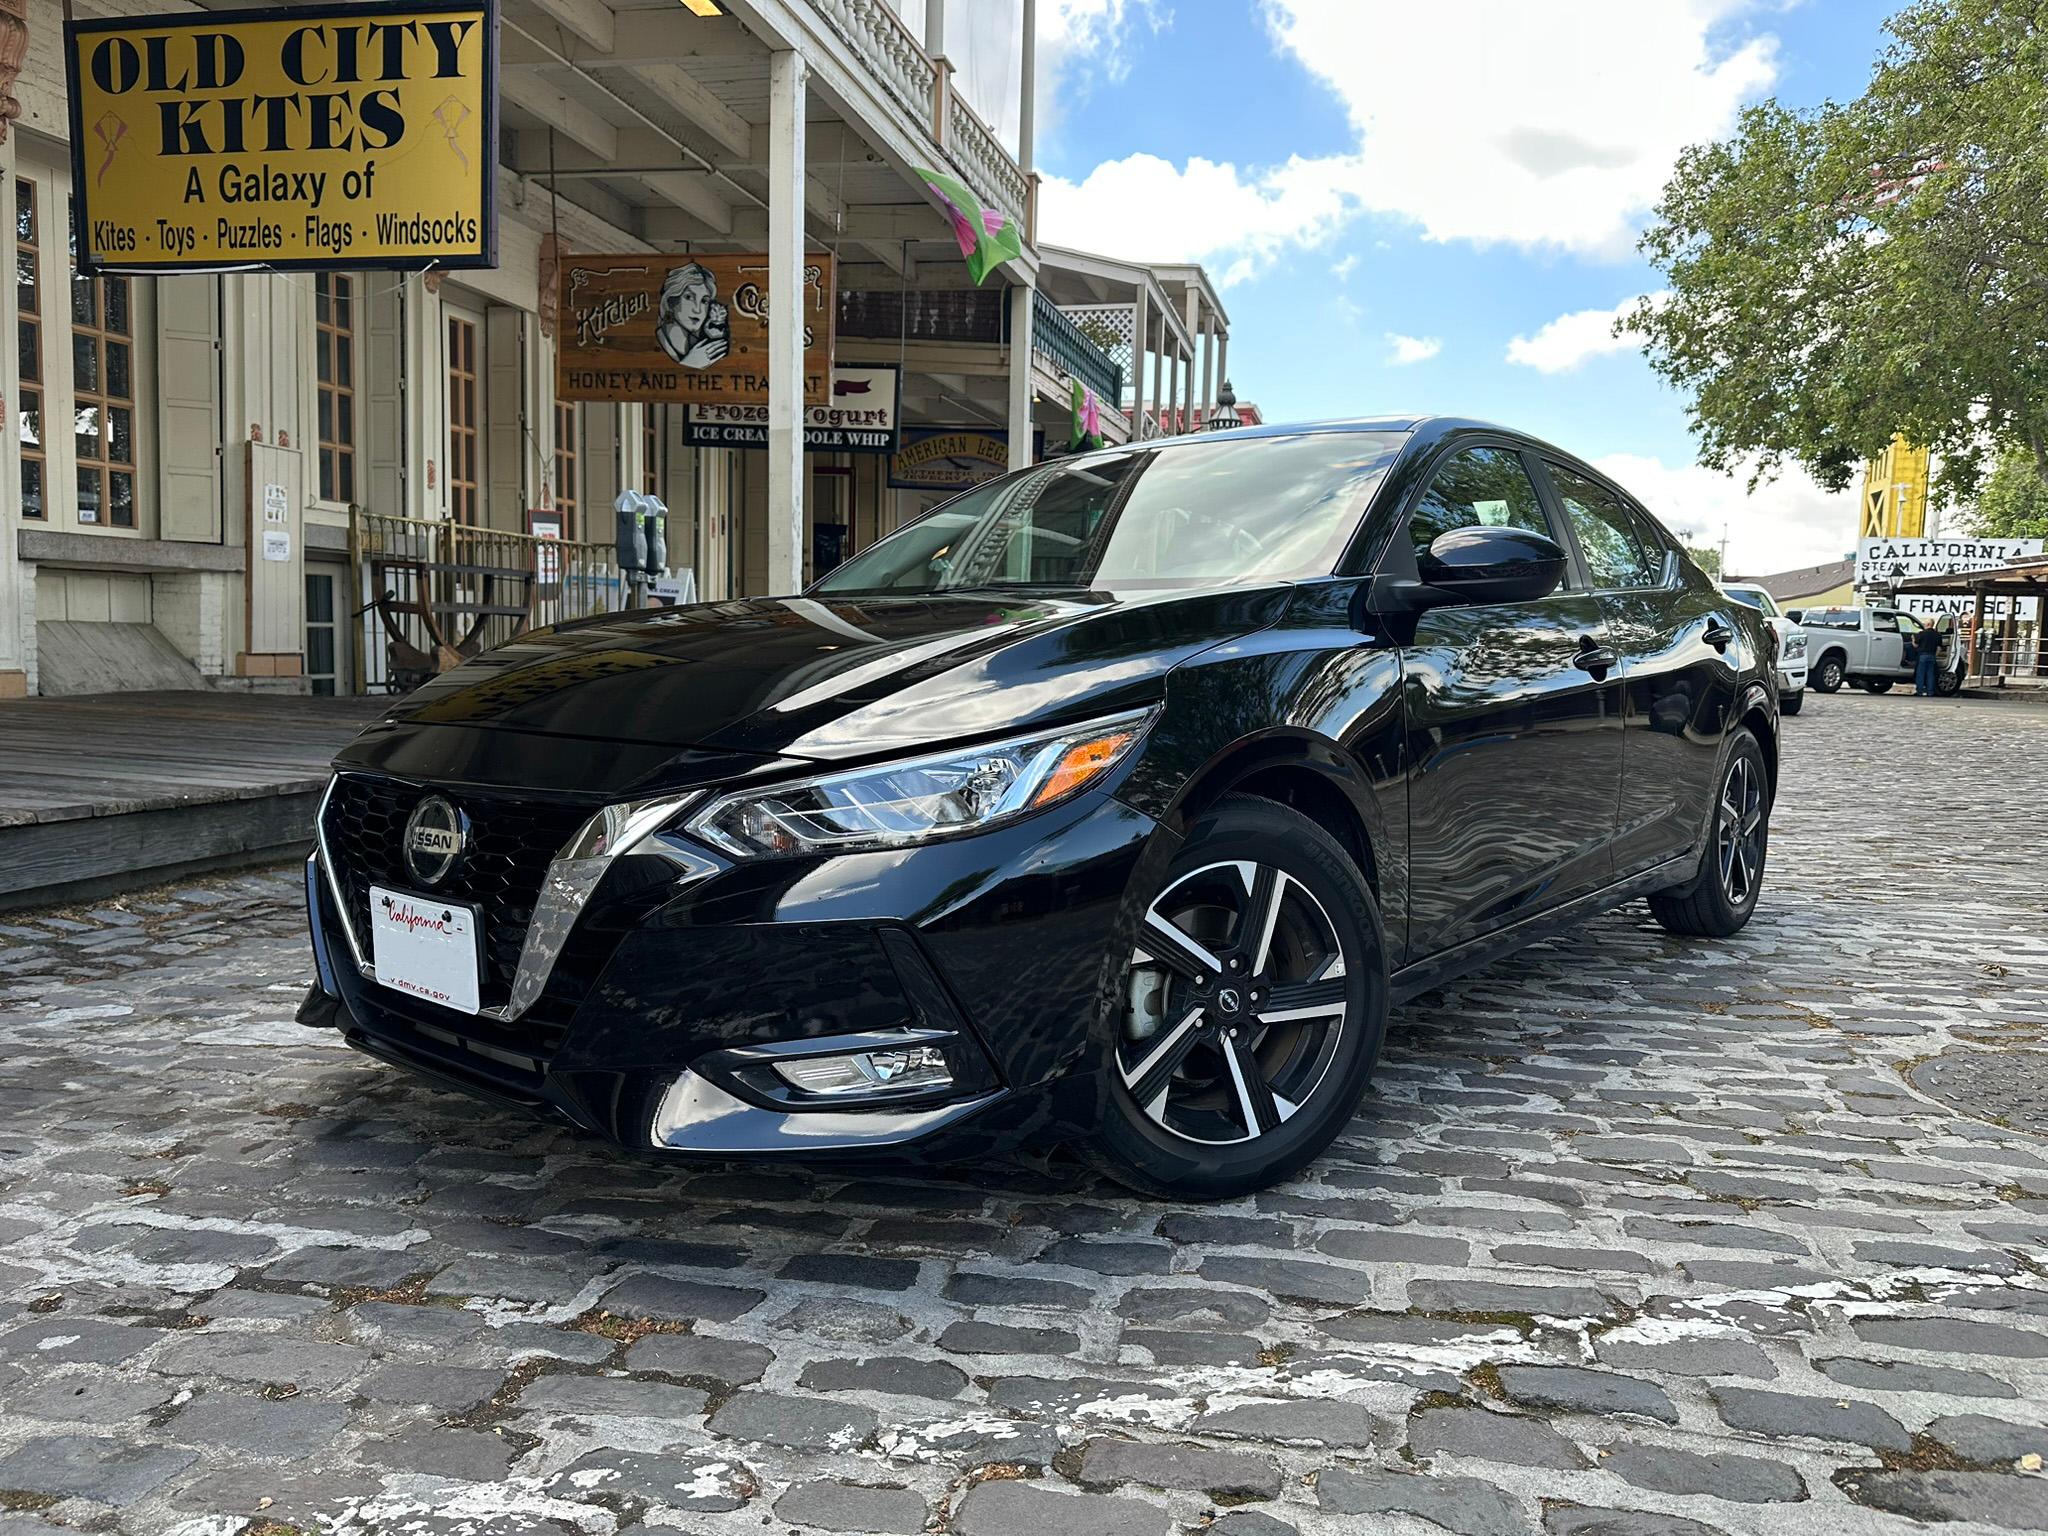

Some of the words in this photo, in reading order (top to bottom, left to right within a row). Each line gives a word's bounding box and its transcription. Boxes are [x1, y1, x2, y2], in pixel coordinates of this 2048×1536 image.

[91, 33, 245, 94] OLD
[280, 19, 478, 86] CITY
[155, 87, 406, 156] KITES
[184, 166, 205, 203] A
[218, 163, 327, 208] Galaxy
[342, 160, 375, 200] of
[94, 219, 136, 252] Kites
[156, 218, 195, 256] Toys
[217, 216, 282, 249] Puzzles
[305, 214, 353, 253] Flags
[376, 210, 477, 246] Windsocks
[569, 372, 632, 392] HONEY
[639, 372, 677, 390] AND
[684, 374, 722, 391] THE
[696, 403, 769, 420] Froze
[692, 426, 719, 440] ICE
[723, 427, 769, 442] CREA
[847, 432, 890, 447] WHIP
[896, 436, 967, 470] AMERICAN
[1869, 543, 2022, 560] CALIFORNIA
[1861, 561, 1910, 572] STEAM
[1909, 599, 2027, 615] FRANCSCO.
[411, 830, 452, 850] SSAN
[389, 900, 453, 933] California
